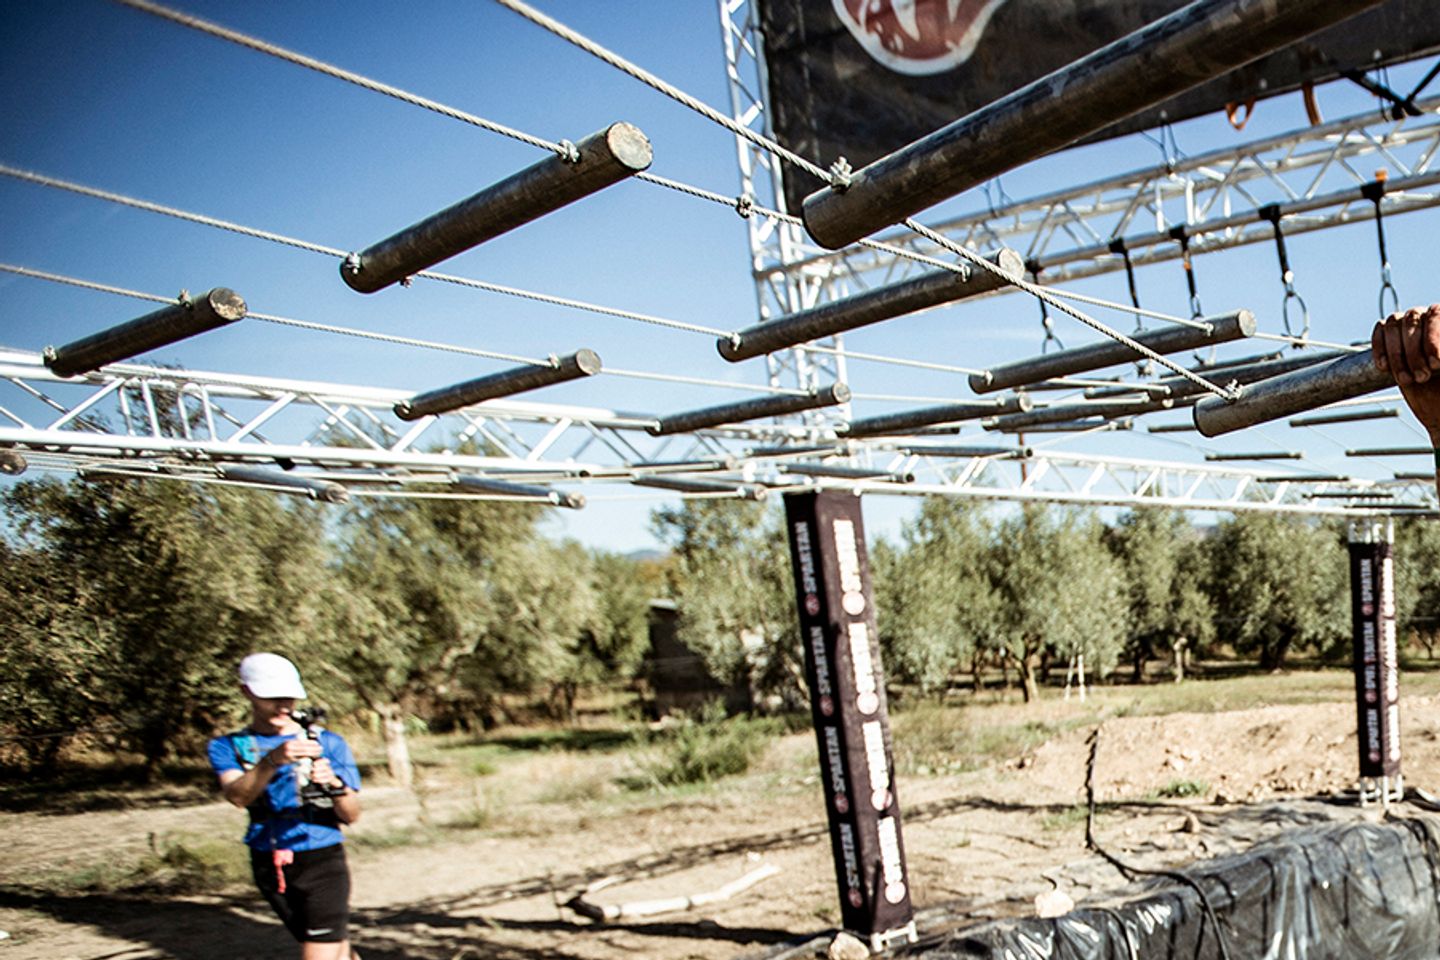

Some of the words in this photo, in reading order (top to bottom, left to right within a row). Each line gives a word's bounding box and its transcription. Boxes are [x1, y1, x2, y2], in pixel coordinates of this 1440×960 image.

[795, 522, 817, 594] SPARTAN
[810, 626, 832, 696] SPARTAN
[824, 726, 846, 792] SPARTAN
